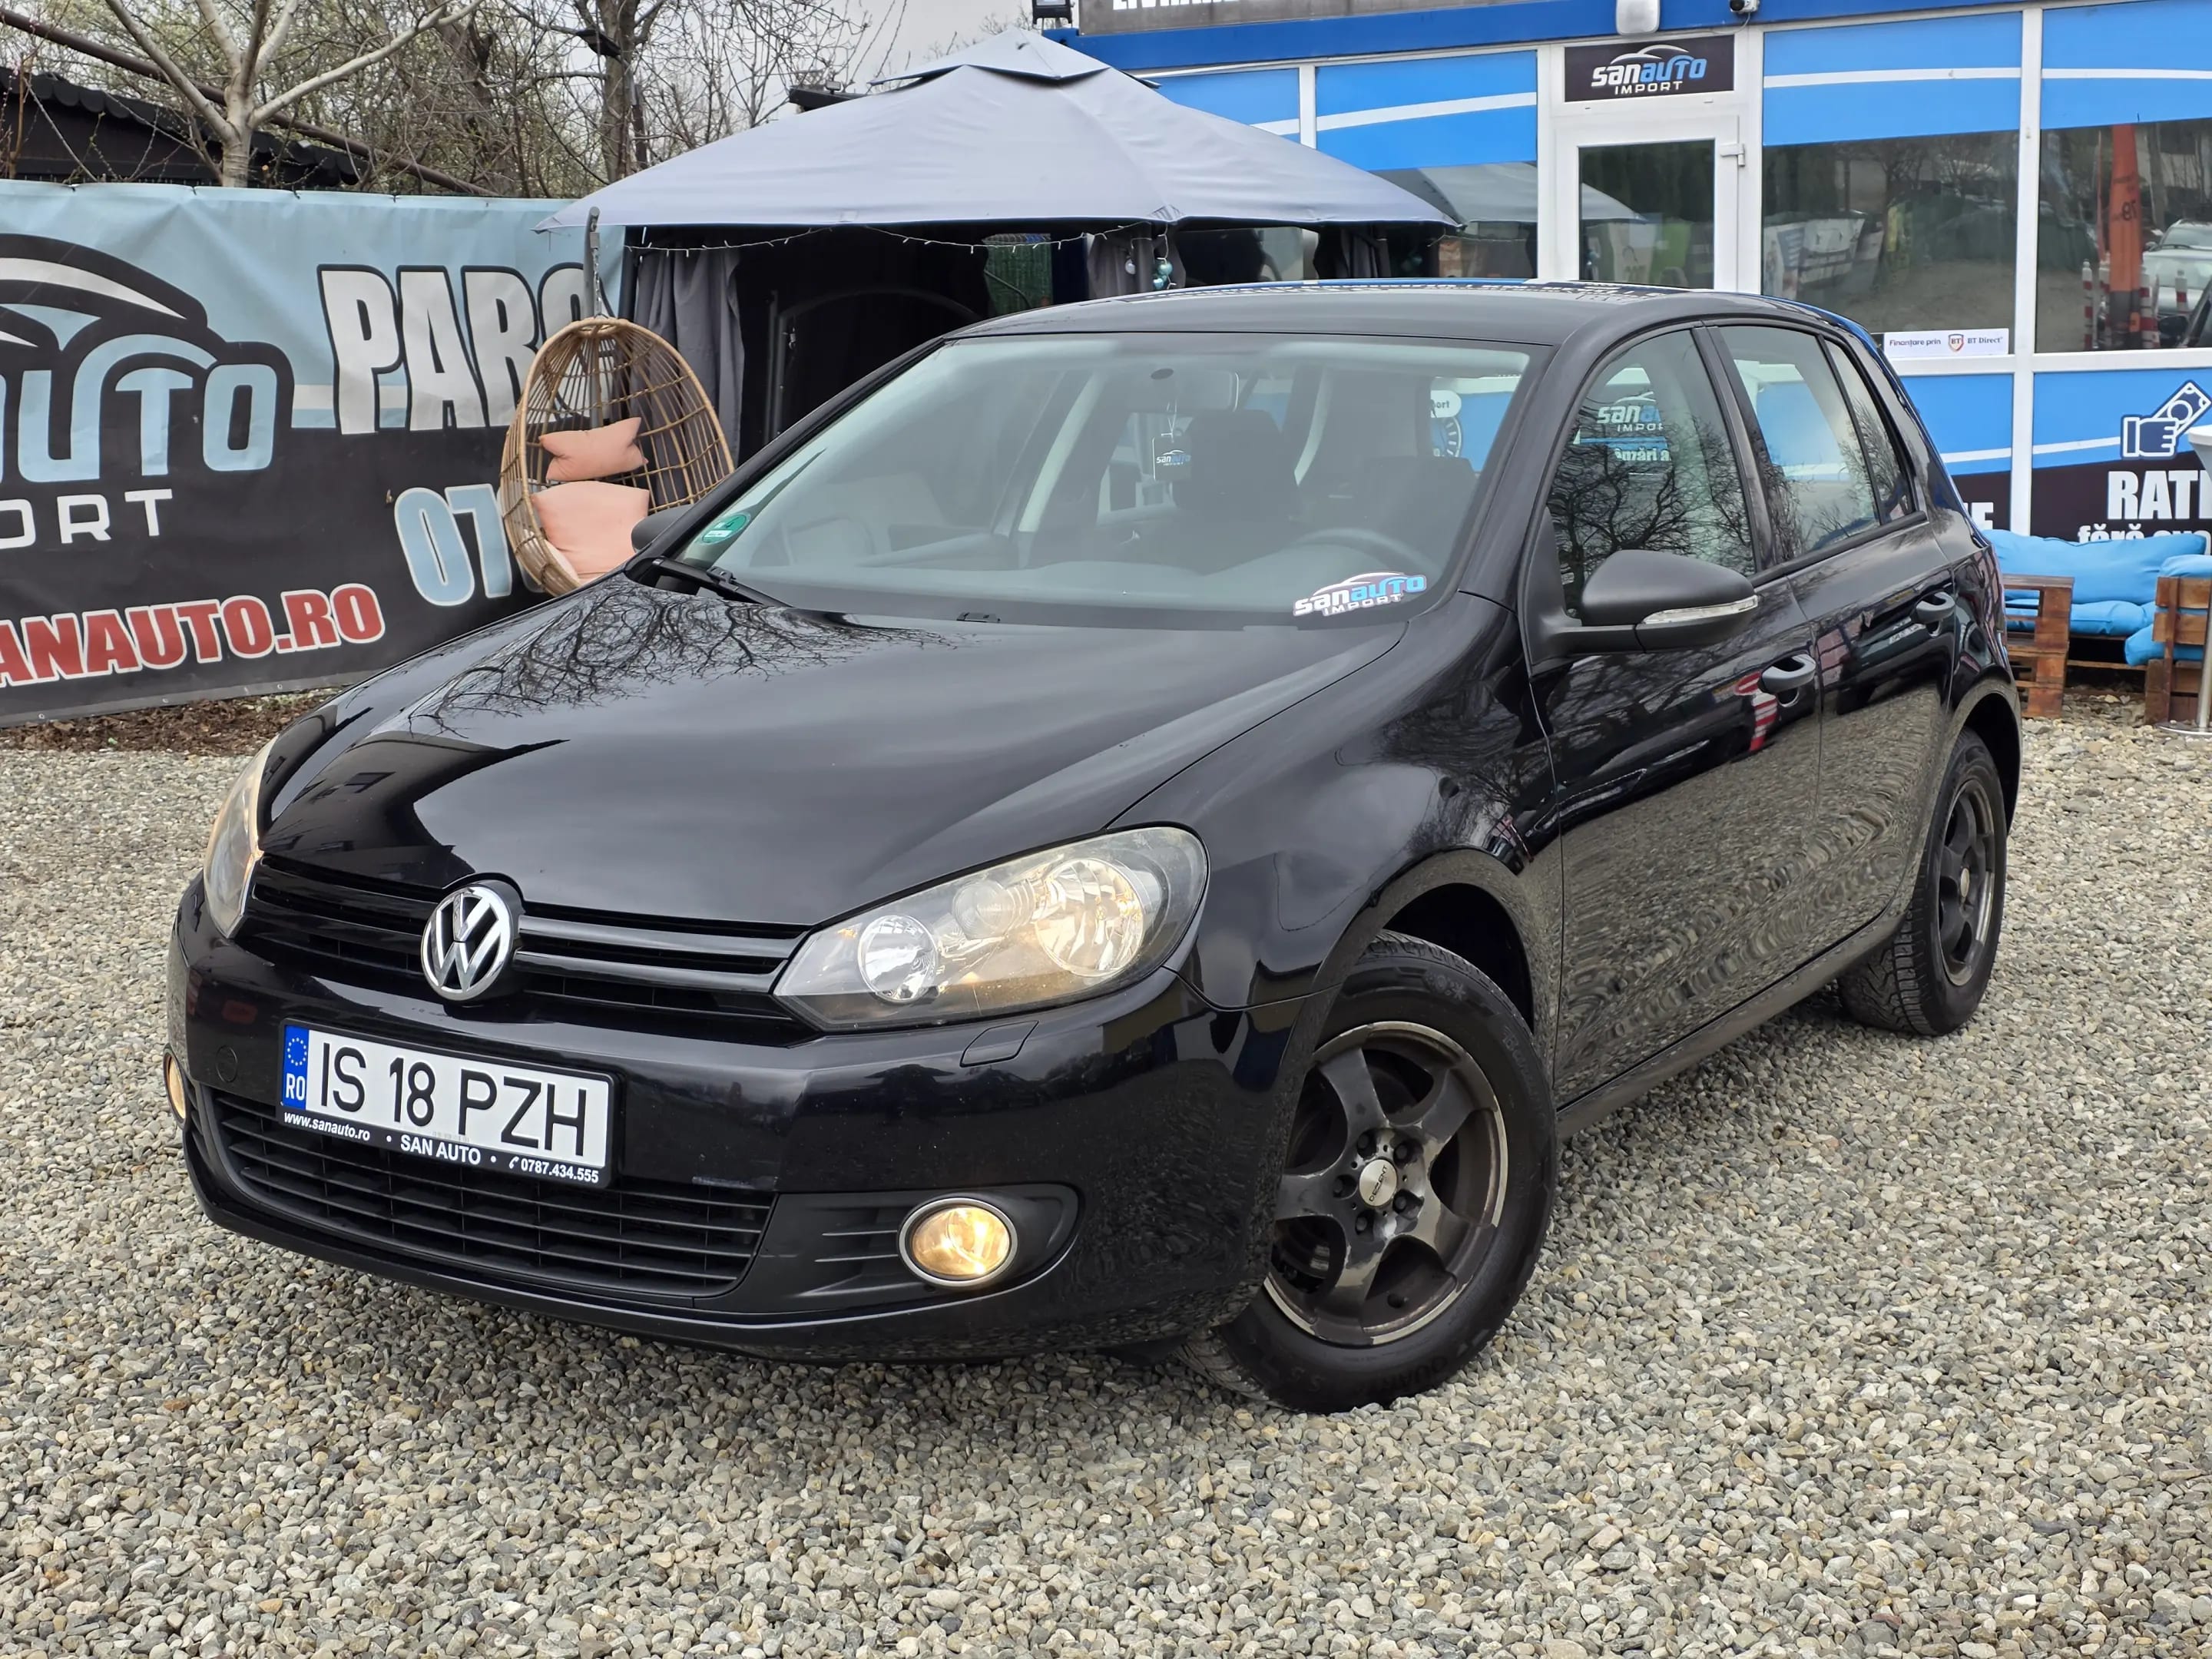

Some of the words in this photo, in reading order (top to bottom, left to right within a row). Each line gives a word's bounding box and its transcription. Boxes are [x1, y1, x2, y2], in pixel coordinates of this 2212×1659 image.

[1614, 81, 1683, 94] IMPORT
[1324, 594, 1402, 615] IMPORT
[286, 1073, 306, 1101] RO
[321, 1042, 366, 1113] IS
[389, 1058, 436, 1128] 18
[459, 1068, 587, 1157] PZH
[283, 1111, 370, 1141] www.sanauto.ro
[400, 1134, 432, 1157] SAN
[435, 1141, 481, 1165] AUTO
[521, 1159, 599, 1184] 0787.434.555
